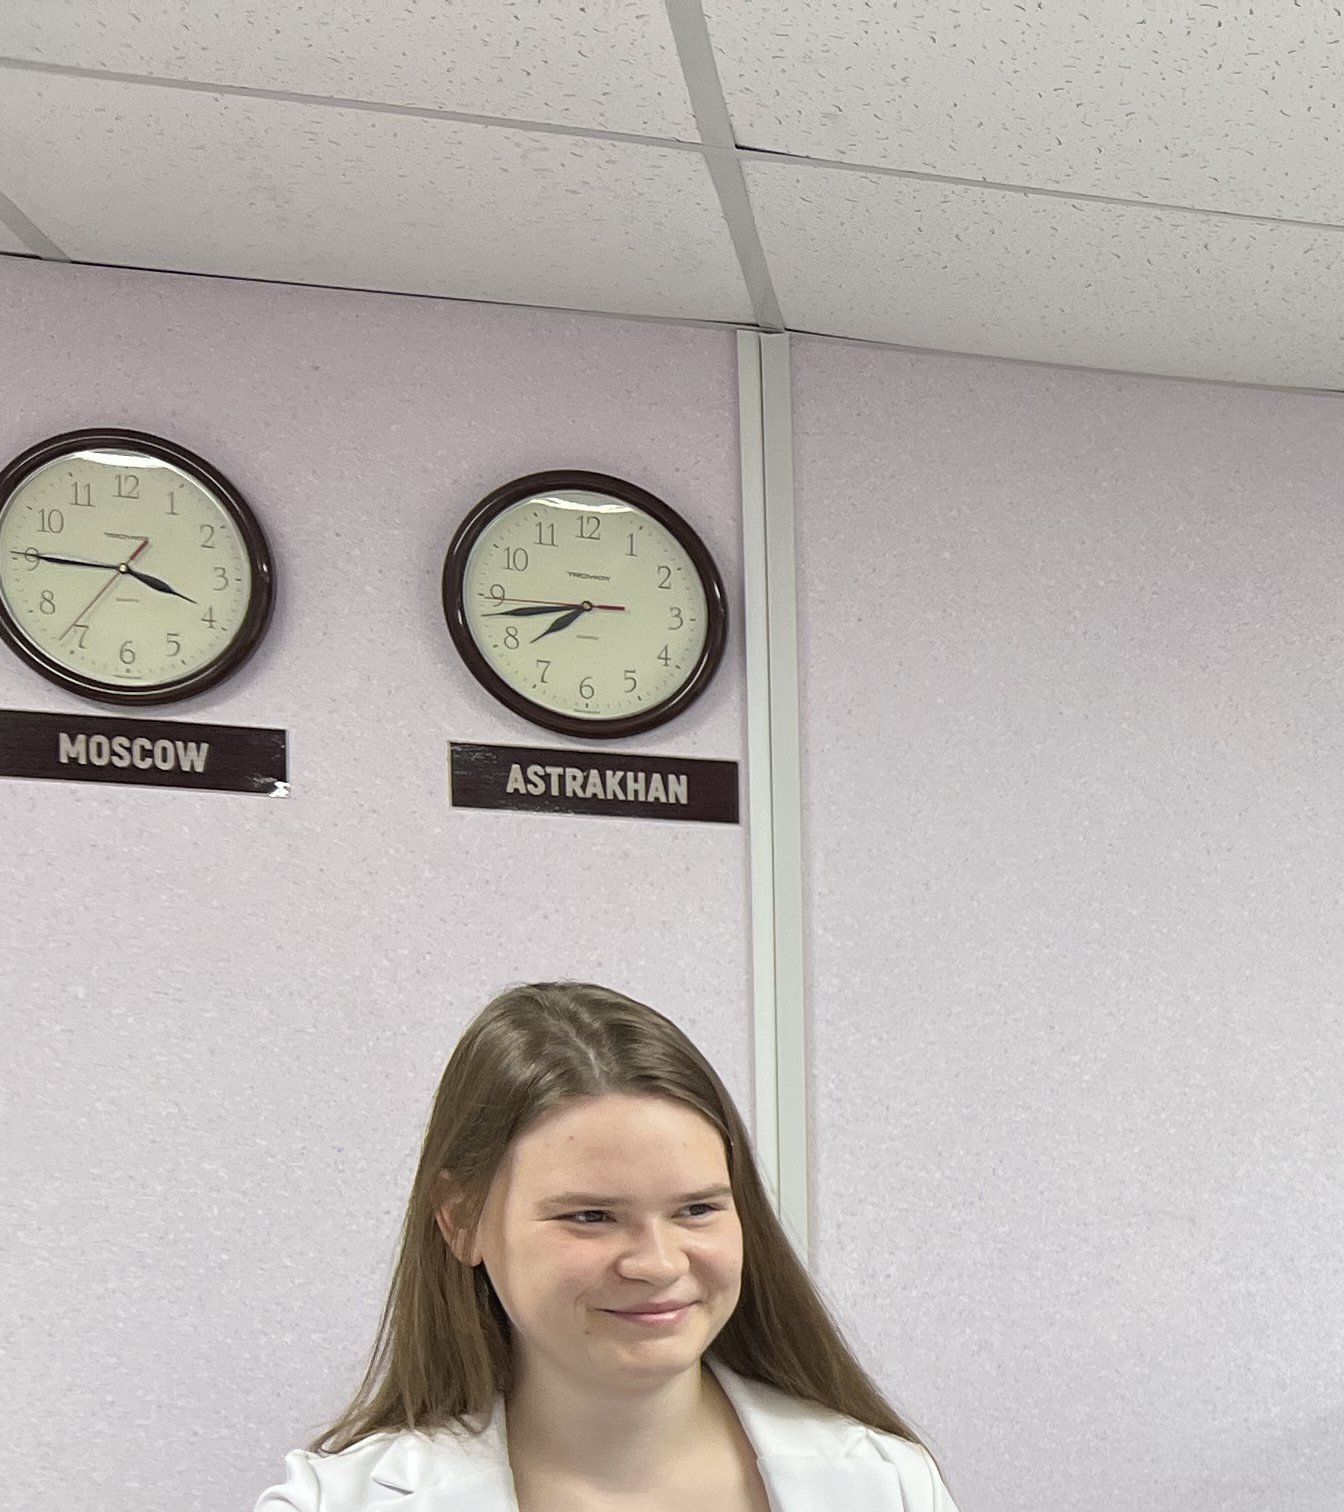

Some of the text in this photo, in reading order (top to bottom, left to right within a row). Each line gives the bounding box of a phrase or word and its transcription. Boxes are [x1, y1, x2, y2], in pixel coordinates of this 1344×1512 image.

[70, 482, 96, 507] 11
[113, 474, 140, 499] 12
[165, 491, 179, 515] 1
[37, 509, 64, 533] 10
[575, 515, 601, 540] 12
[200, 524, 215, 549] 2
[533, 522, 559, 547] 11
[625, 533, 638, 557] 1
[25, 547, 40, 571] 9
[502, 546, 528, 572] 10
[213, 567, 229, 591] 3
[657, 565, 672, 589] 2
[40, 590, 56, 615] 8
[490, 584, 506, 607] 9
[201, 606, 217, 629] 4
[668, 607, 684, 630] 3
[73, 624, 89, 649] 7
[166, 633, 181, 657] 5
[503, 626, 519, 650] 8
[119, 641, 135, 665] 6
[657, 644, 672, 667] 4
[536, 659, 551, 684] 7
[623, 669, 637, 693] 5
[579, 676, 595, 699] 6
[59, 732, 209, 773] MOSCOW
[506, 763, 688, 804] ASTRAKHAN
